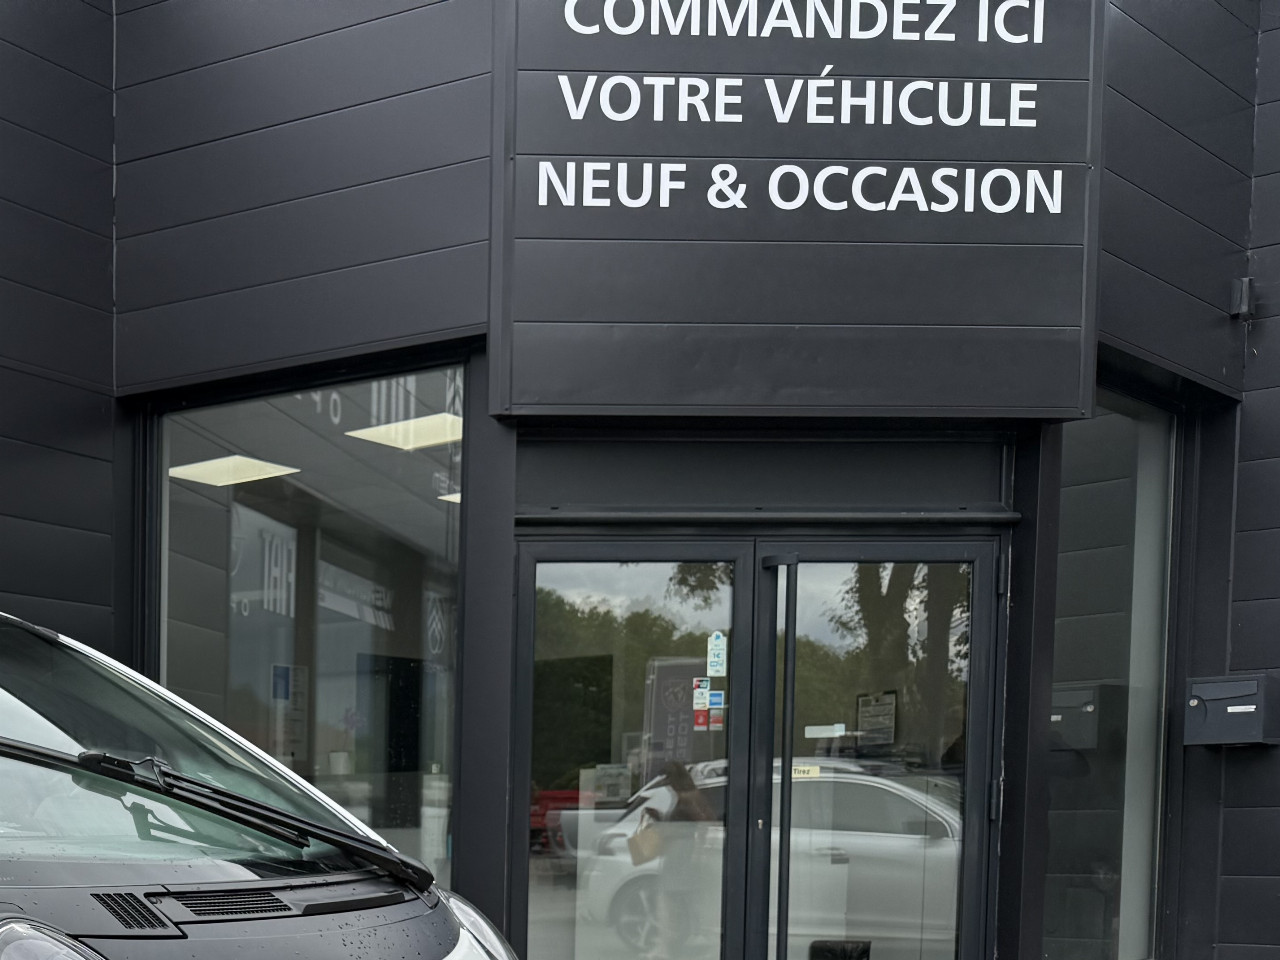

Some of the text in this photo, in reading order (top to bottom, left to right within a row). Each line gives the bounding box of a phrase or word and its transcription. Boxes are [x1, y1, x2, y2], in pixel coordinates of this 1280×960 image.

[564, 0, 1045, 44] COMMANDEZ ICI
[557, 64, 1038, 128] VOTRE VÉHICULE
[538, 161, 1063, 215] NEUF & OCCASION
[792, 767, 811, 776] Tirez
